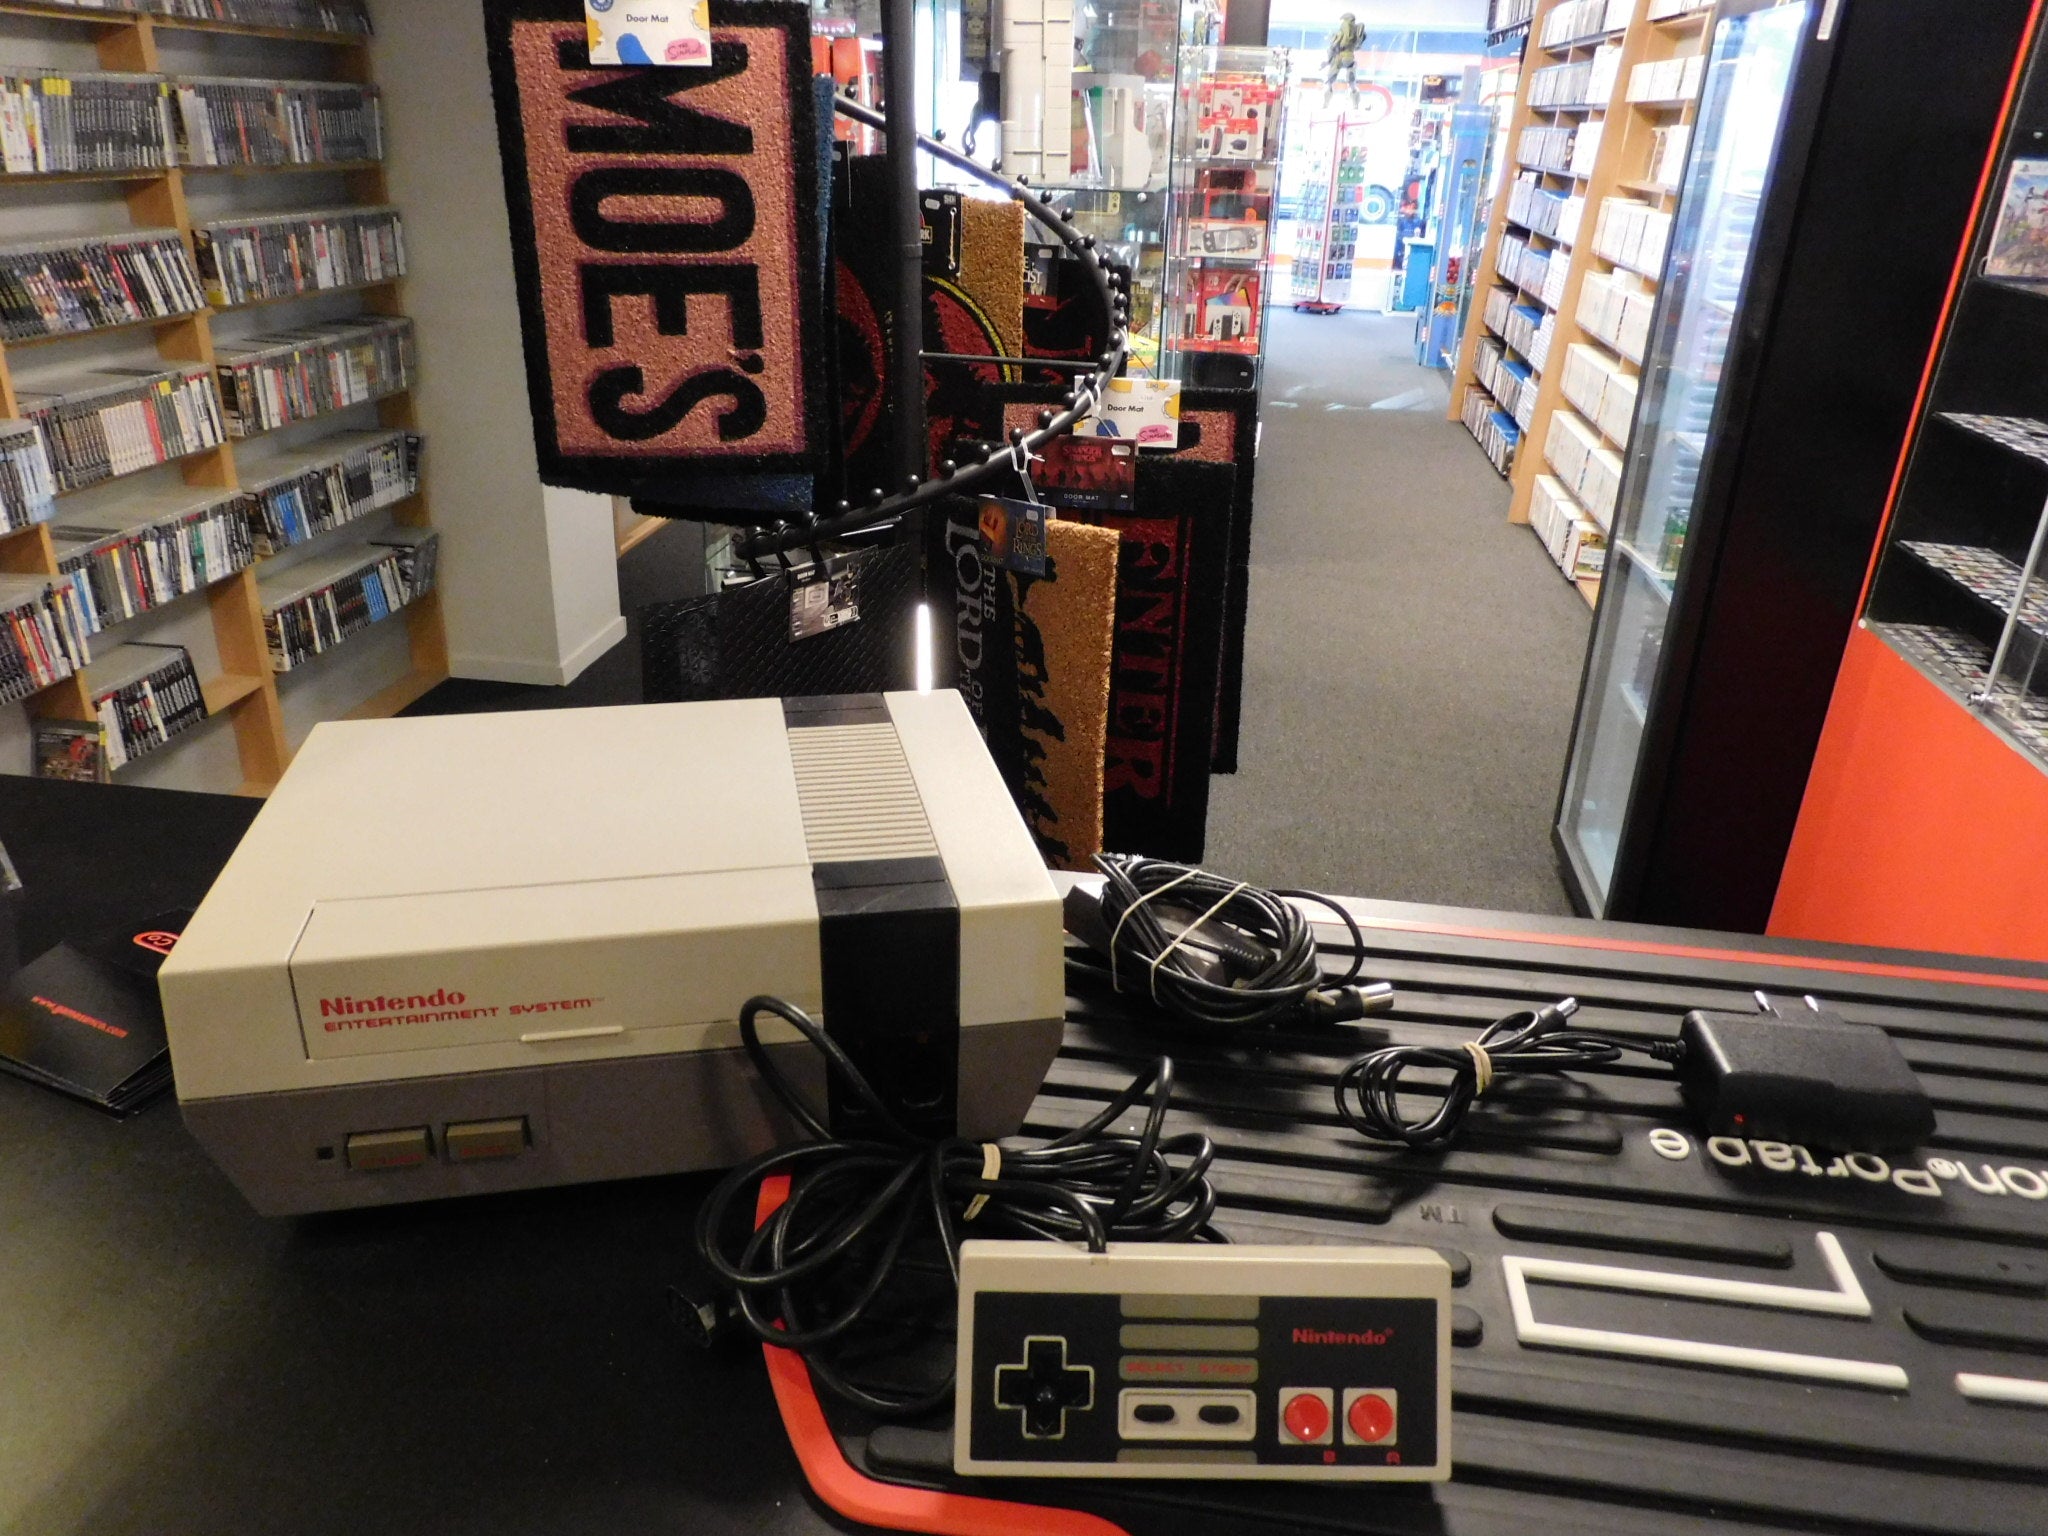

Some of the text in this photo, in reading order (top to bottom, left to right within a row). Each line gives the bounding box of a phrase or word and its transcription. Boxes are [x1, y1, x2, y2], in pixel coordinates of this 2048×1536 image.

[626, 13, 669, 23] Door Mat
[556, 38, 768, 443] MOE'S
[1107, 403, 1145, 413] Door Mat
[1013, 538, 1043, 558] RINGS
[945, 517, 983, 670] LORD
[1103, 514, 1181, 801] ENTER
[319, 988, 466, 1017] Nintendo
[324, 1007, 499, 1032] ENTERTAINMENT
